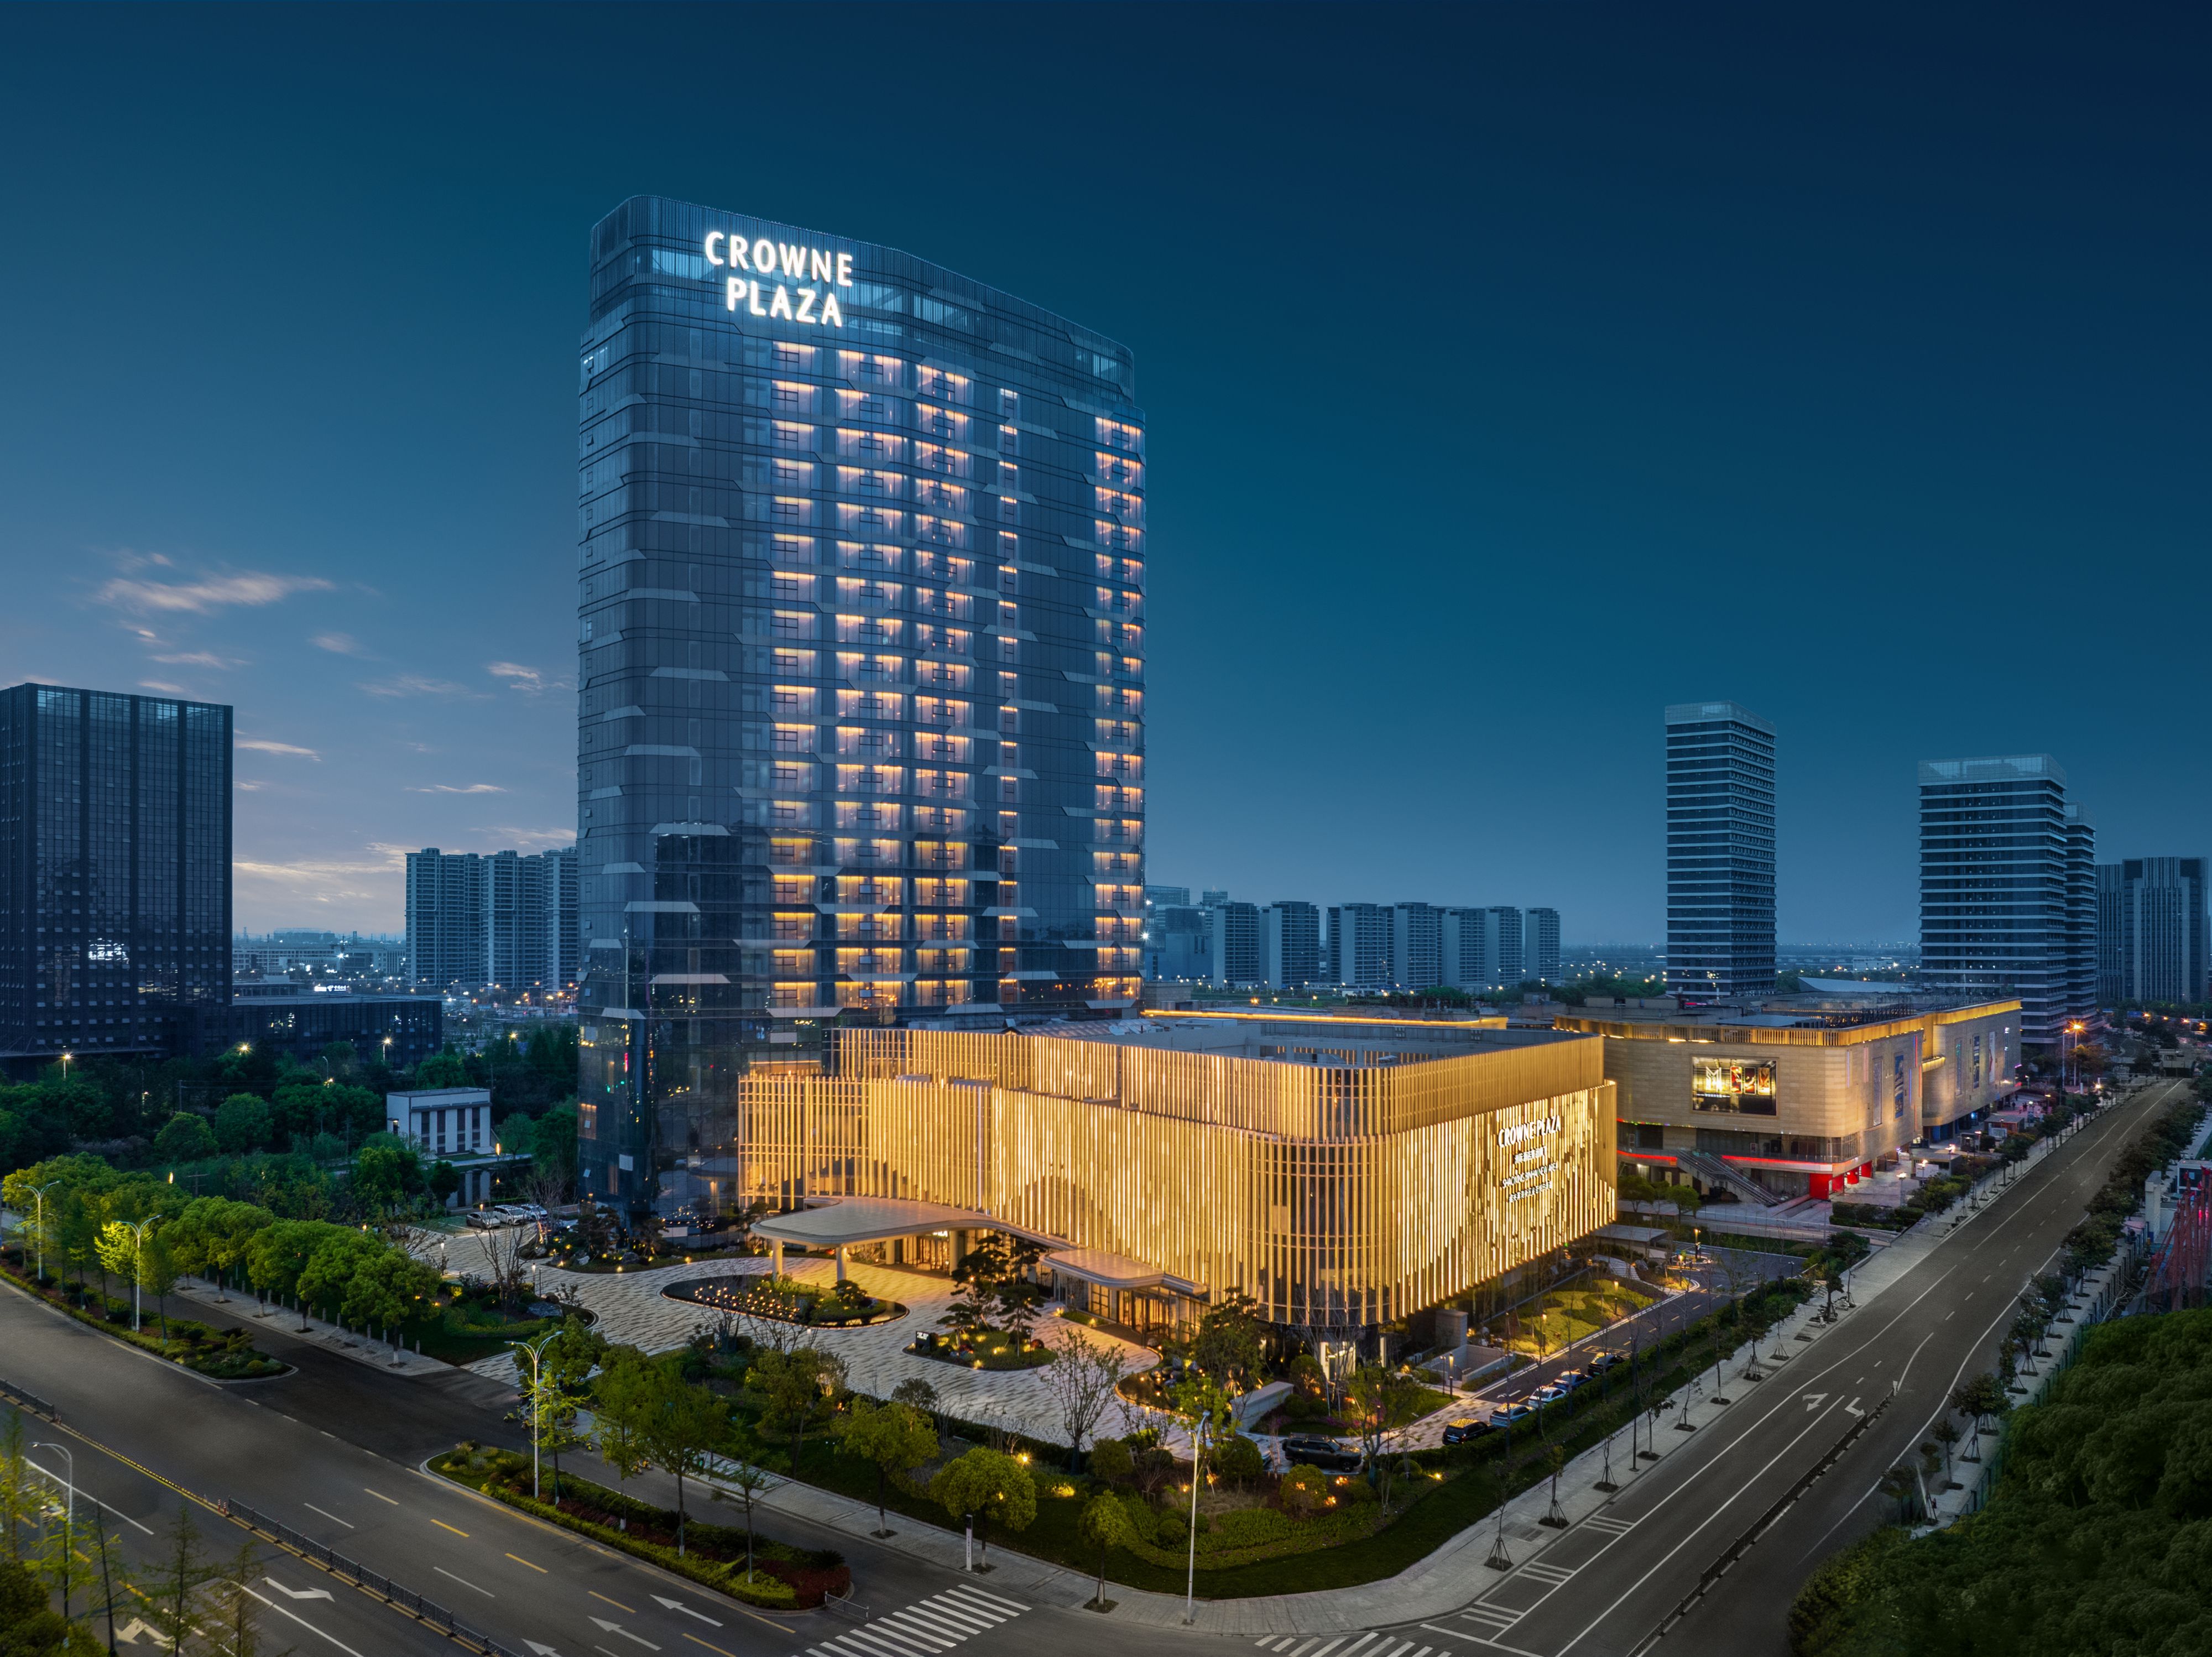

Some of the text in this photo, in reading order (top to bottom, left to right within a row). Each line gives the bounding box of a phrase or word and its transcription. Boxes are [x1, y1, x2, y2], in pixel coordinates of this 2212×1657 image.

[705, 231, 853, 287] CROWNE
[727, 277, 842, 327] PLAZA
[1498, 1114, 1561, 1148] CROWNE PLAZA
